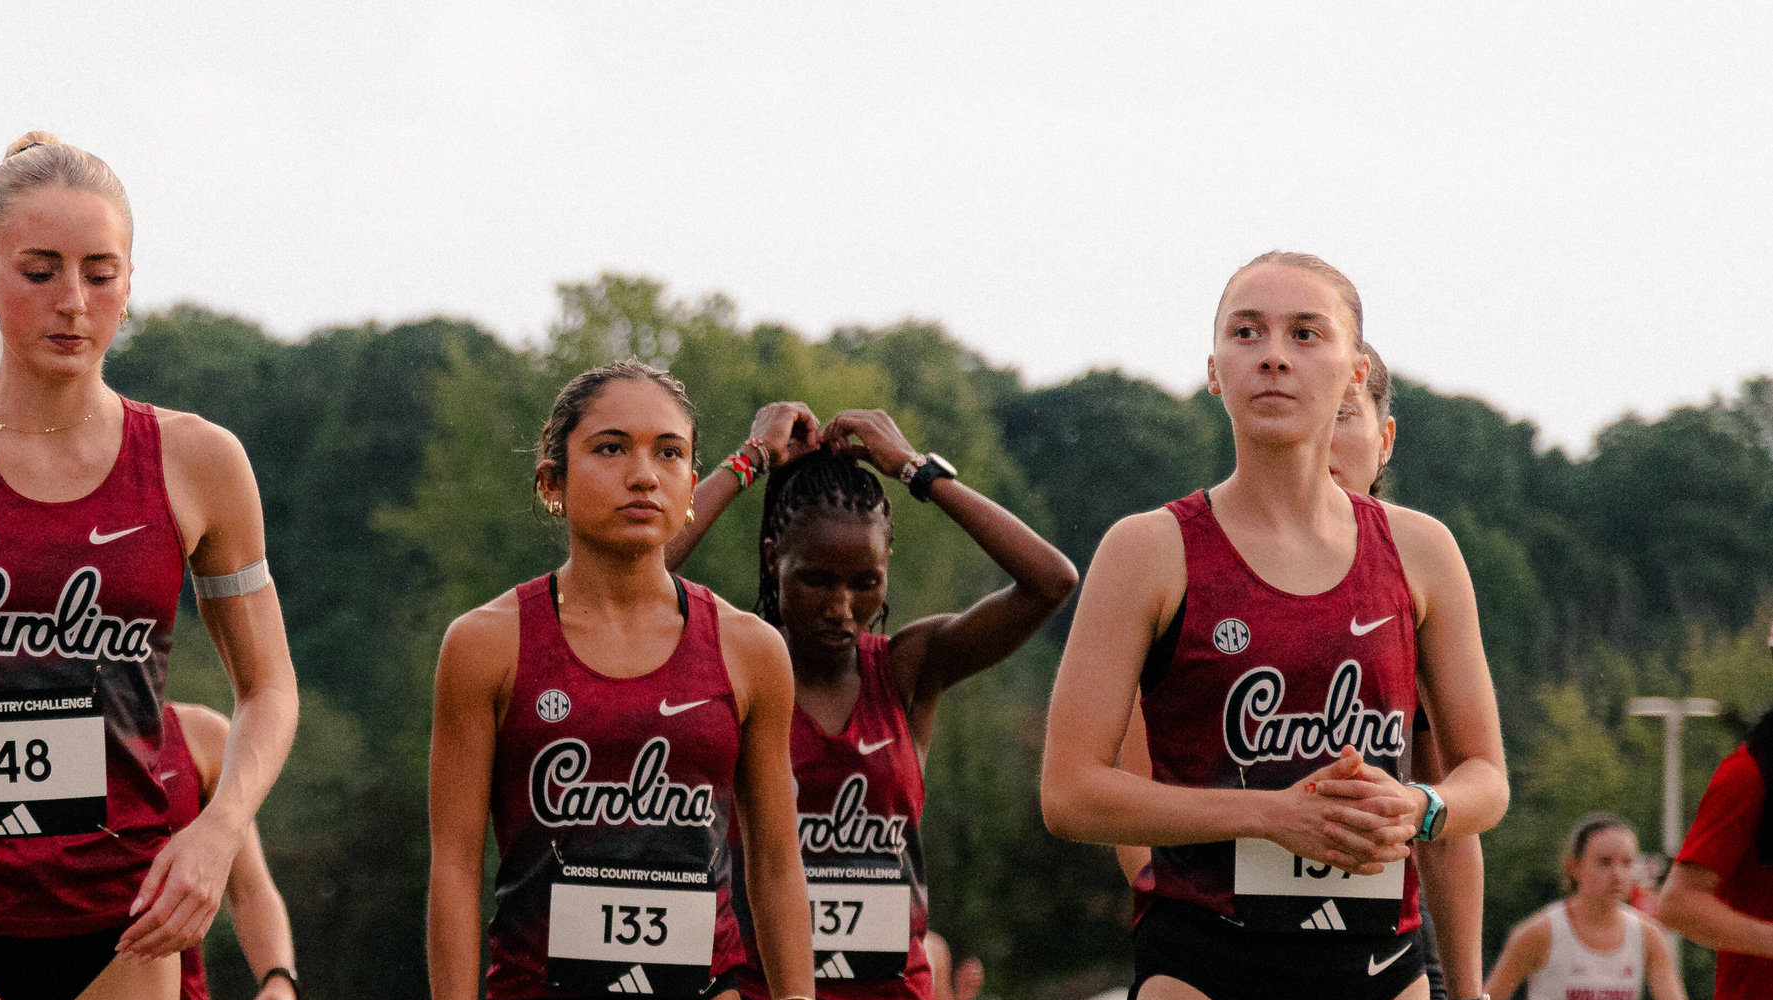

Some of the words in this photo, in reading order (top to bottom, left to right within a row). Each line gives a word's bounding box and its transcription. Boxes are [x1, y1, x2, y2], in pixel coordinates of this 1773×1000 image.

[1216, 621, 1248, 651] SEC
[24, 697, 93, 710] CHALLENGE
[539, 690, 568, 720] SEC
[1223, 659, 1405, 766] Carolina
[529, 736, 716, 827] Carolina
[797, 773, 908, 854] rolina
[563, 865, 599, 878] CROSS
[600, 867, 651, 881] COUNTRY
[651, 869, 708, 884] CHALLENGE
[845, 868, 901, 879] CHALLENGE
[601, 904, 668, 946] 133
